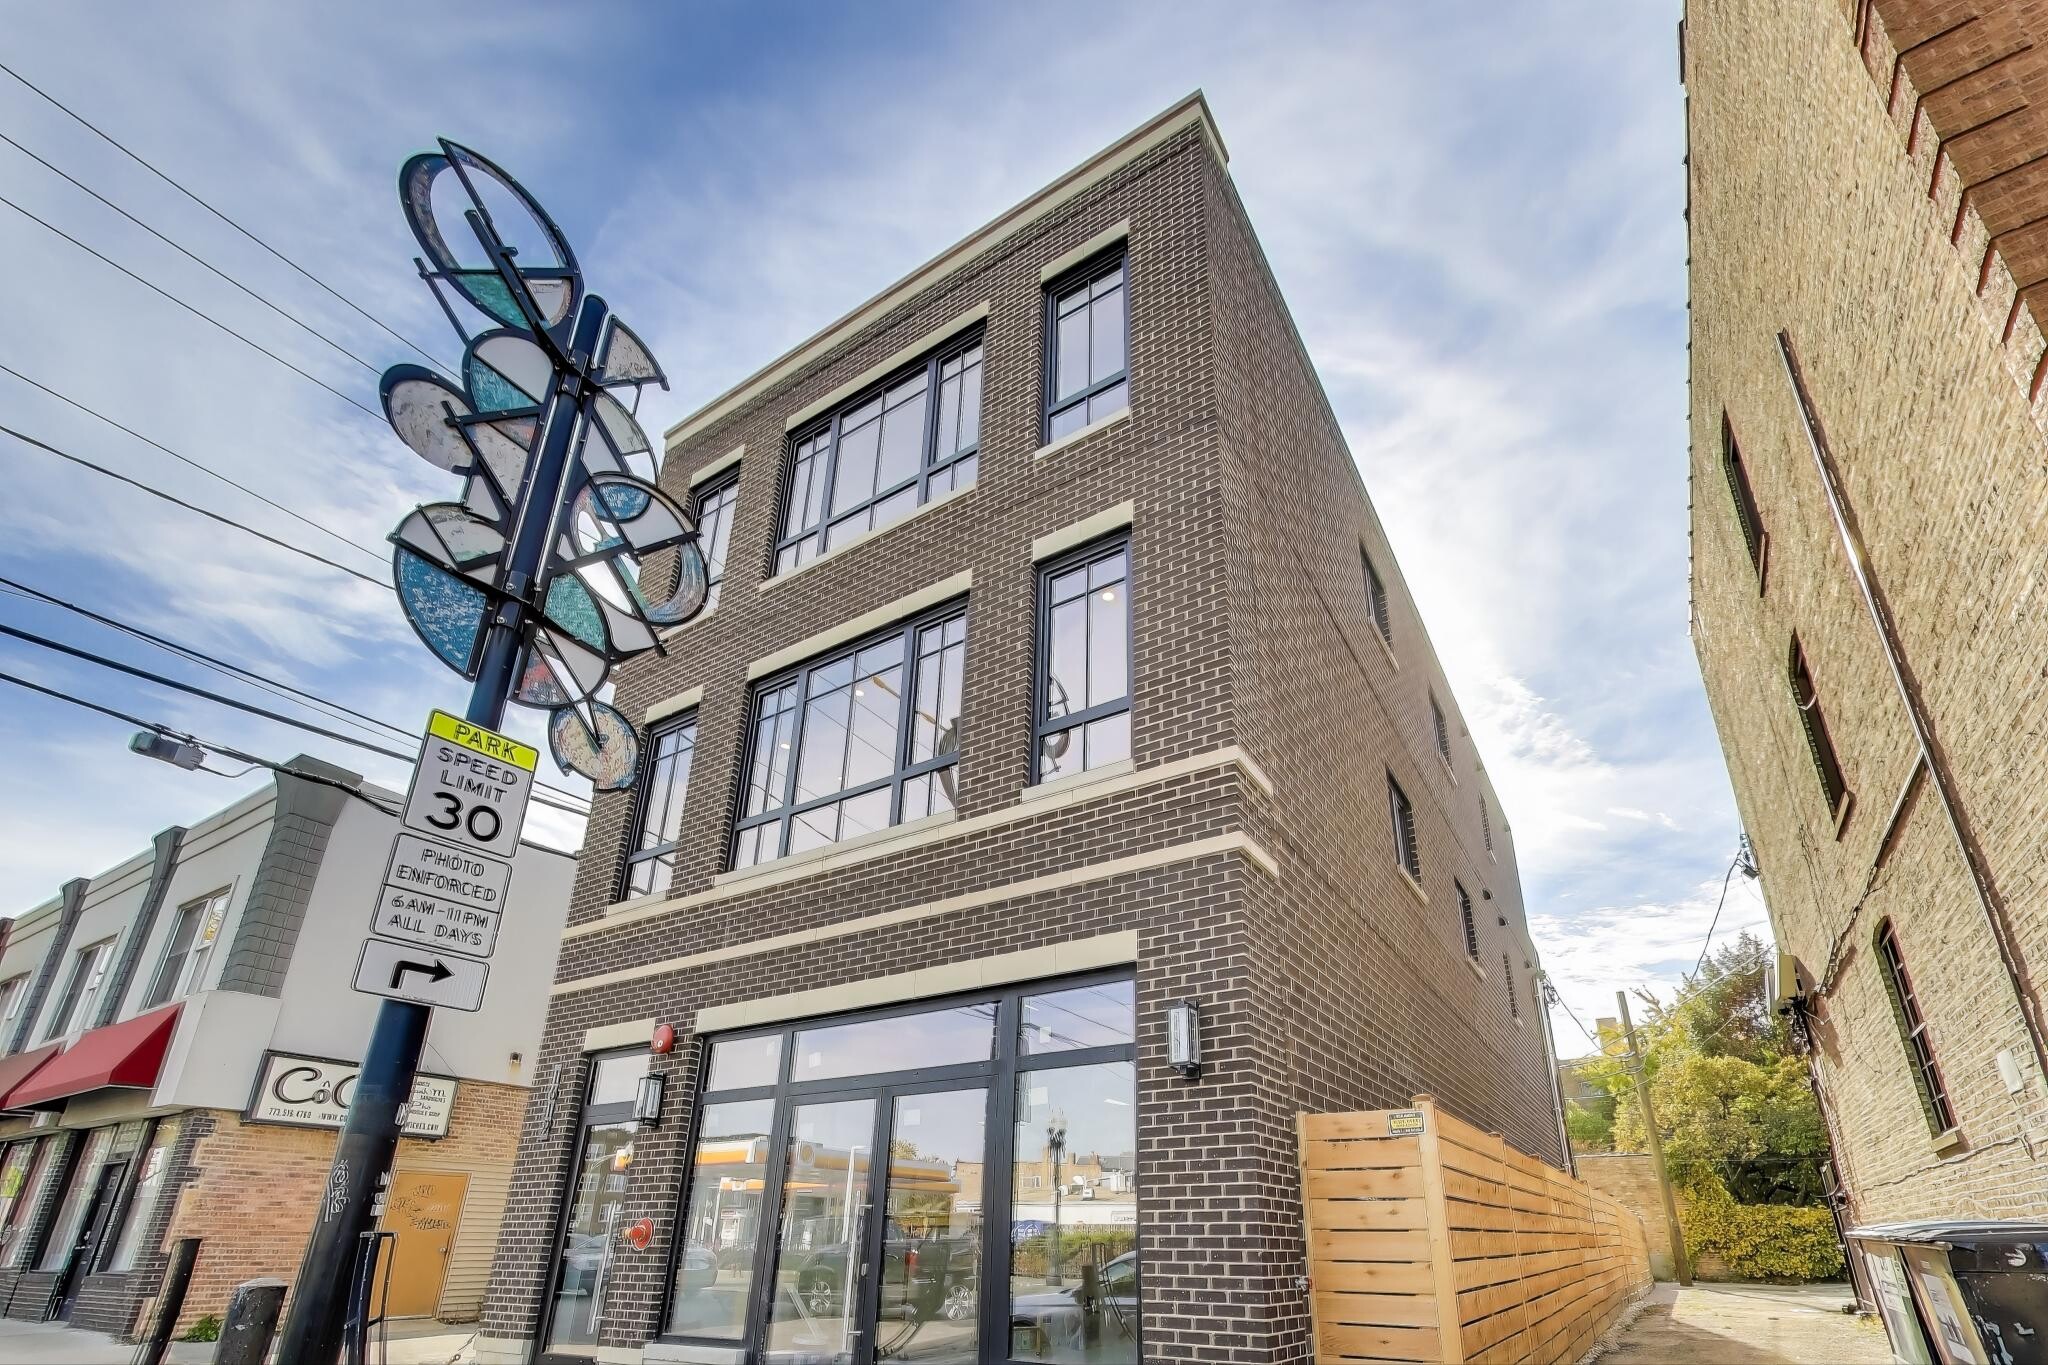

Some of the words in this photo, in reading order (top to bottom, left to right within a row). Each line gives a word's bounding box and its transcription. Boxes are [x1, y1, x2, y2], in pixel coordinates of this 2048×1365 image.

[454, 724, 518, 762] PARK
[437, 747, 517, 785] SPEED
[440, 769, 507, 803] LIMIT
[424, 791, 502, 842] 30
[421, 848, 484, 876] PHOTO
[396, 864, 497, 902] ENFORCED
[388, 914, 426, 933] ALL
[434, 924, 483, 946] DAYS
